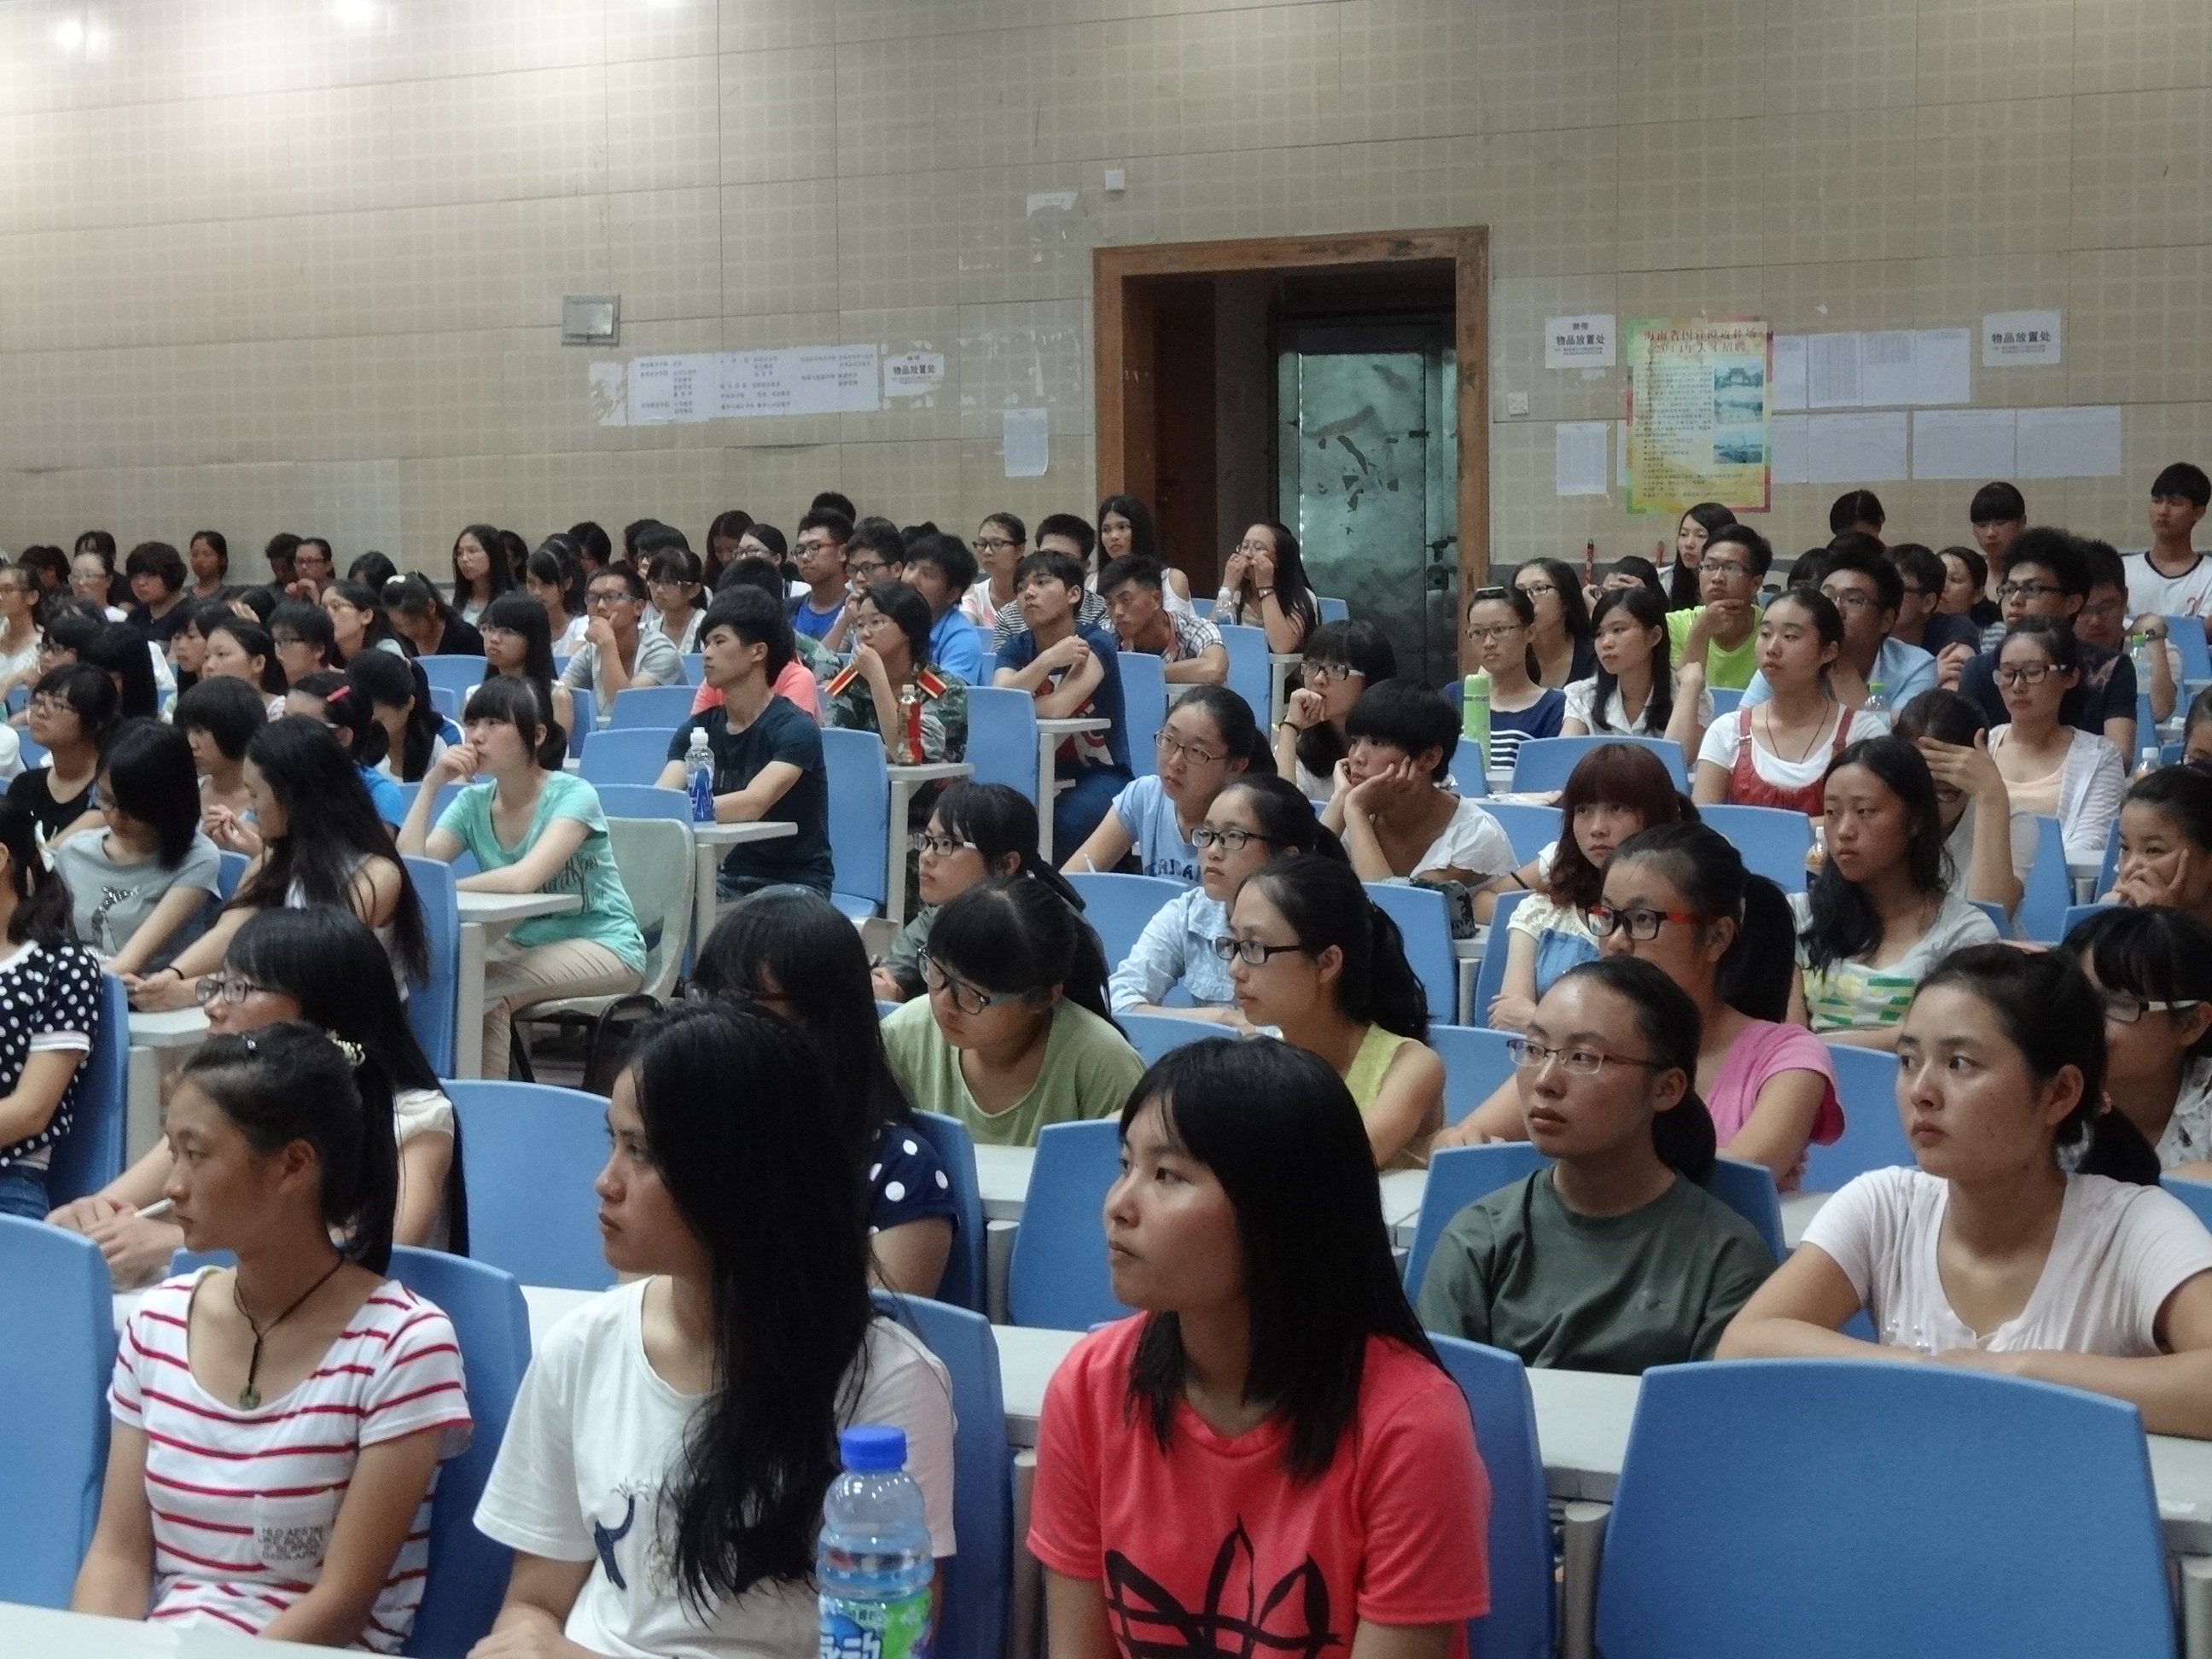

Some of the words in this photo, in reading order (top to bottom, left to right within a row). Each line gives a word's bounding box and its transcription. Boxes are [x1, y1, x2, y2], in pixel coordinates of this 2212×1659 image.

[1556, 334, 1605, 346] 物品放置处
[1991, 330, 2052, 344] 物品放置处
[893, 364, 936, 375] 物品放置处
